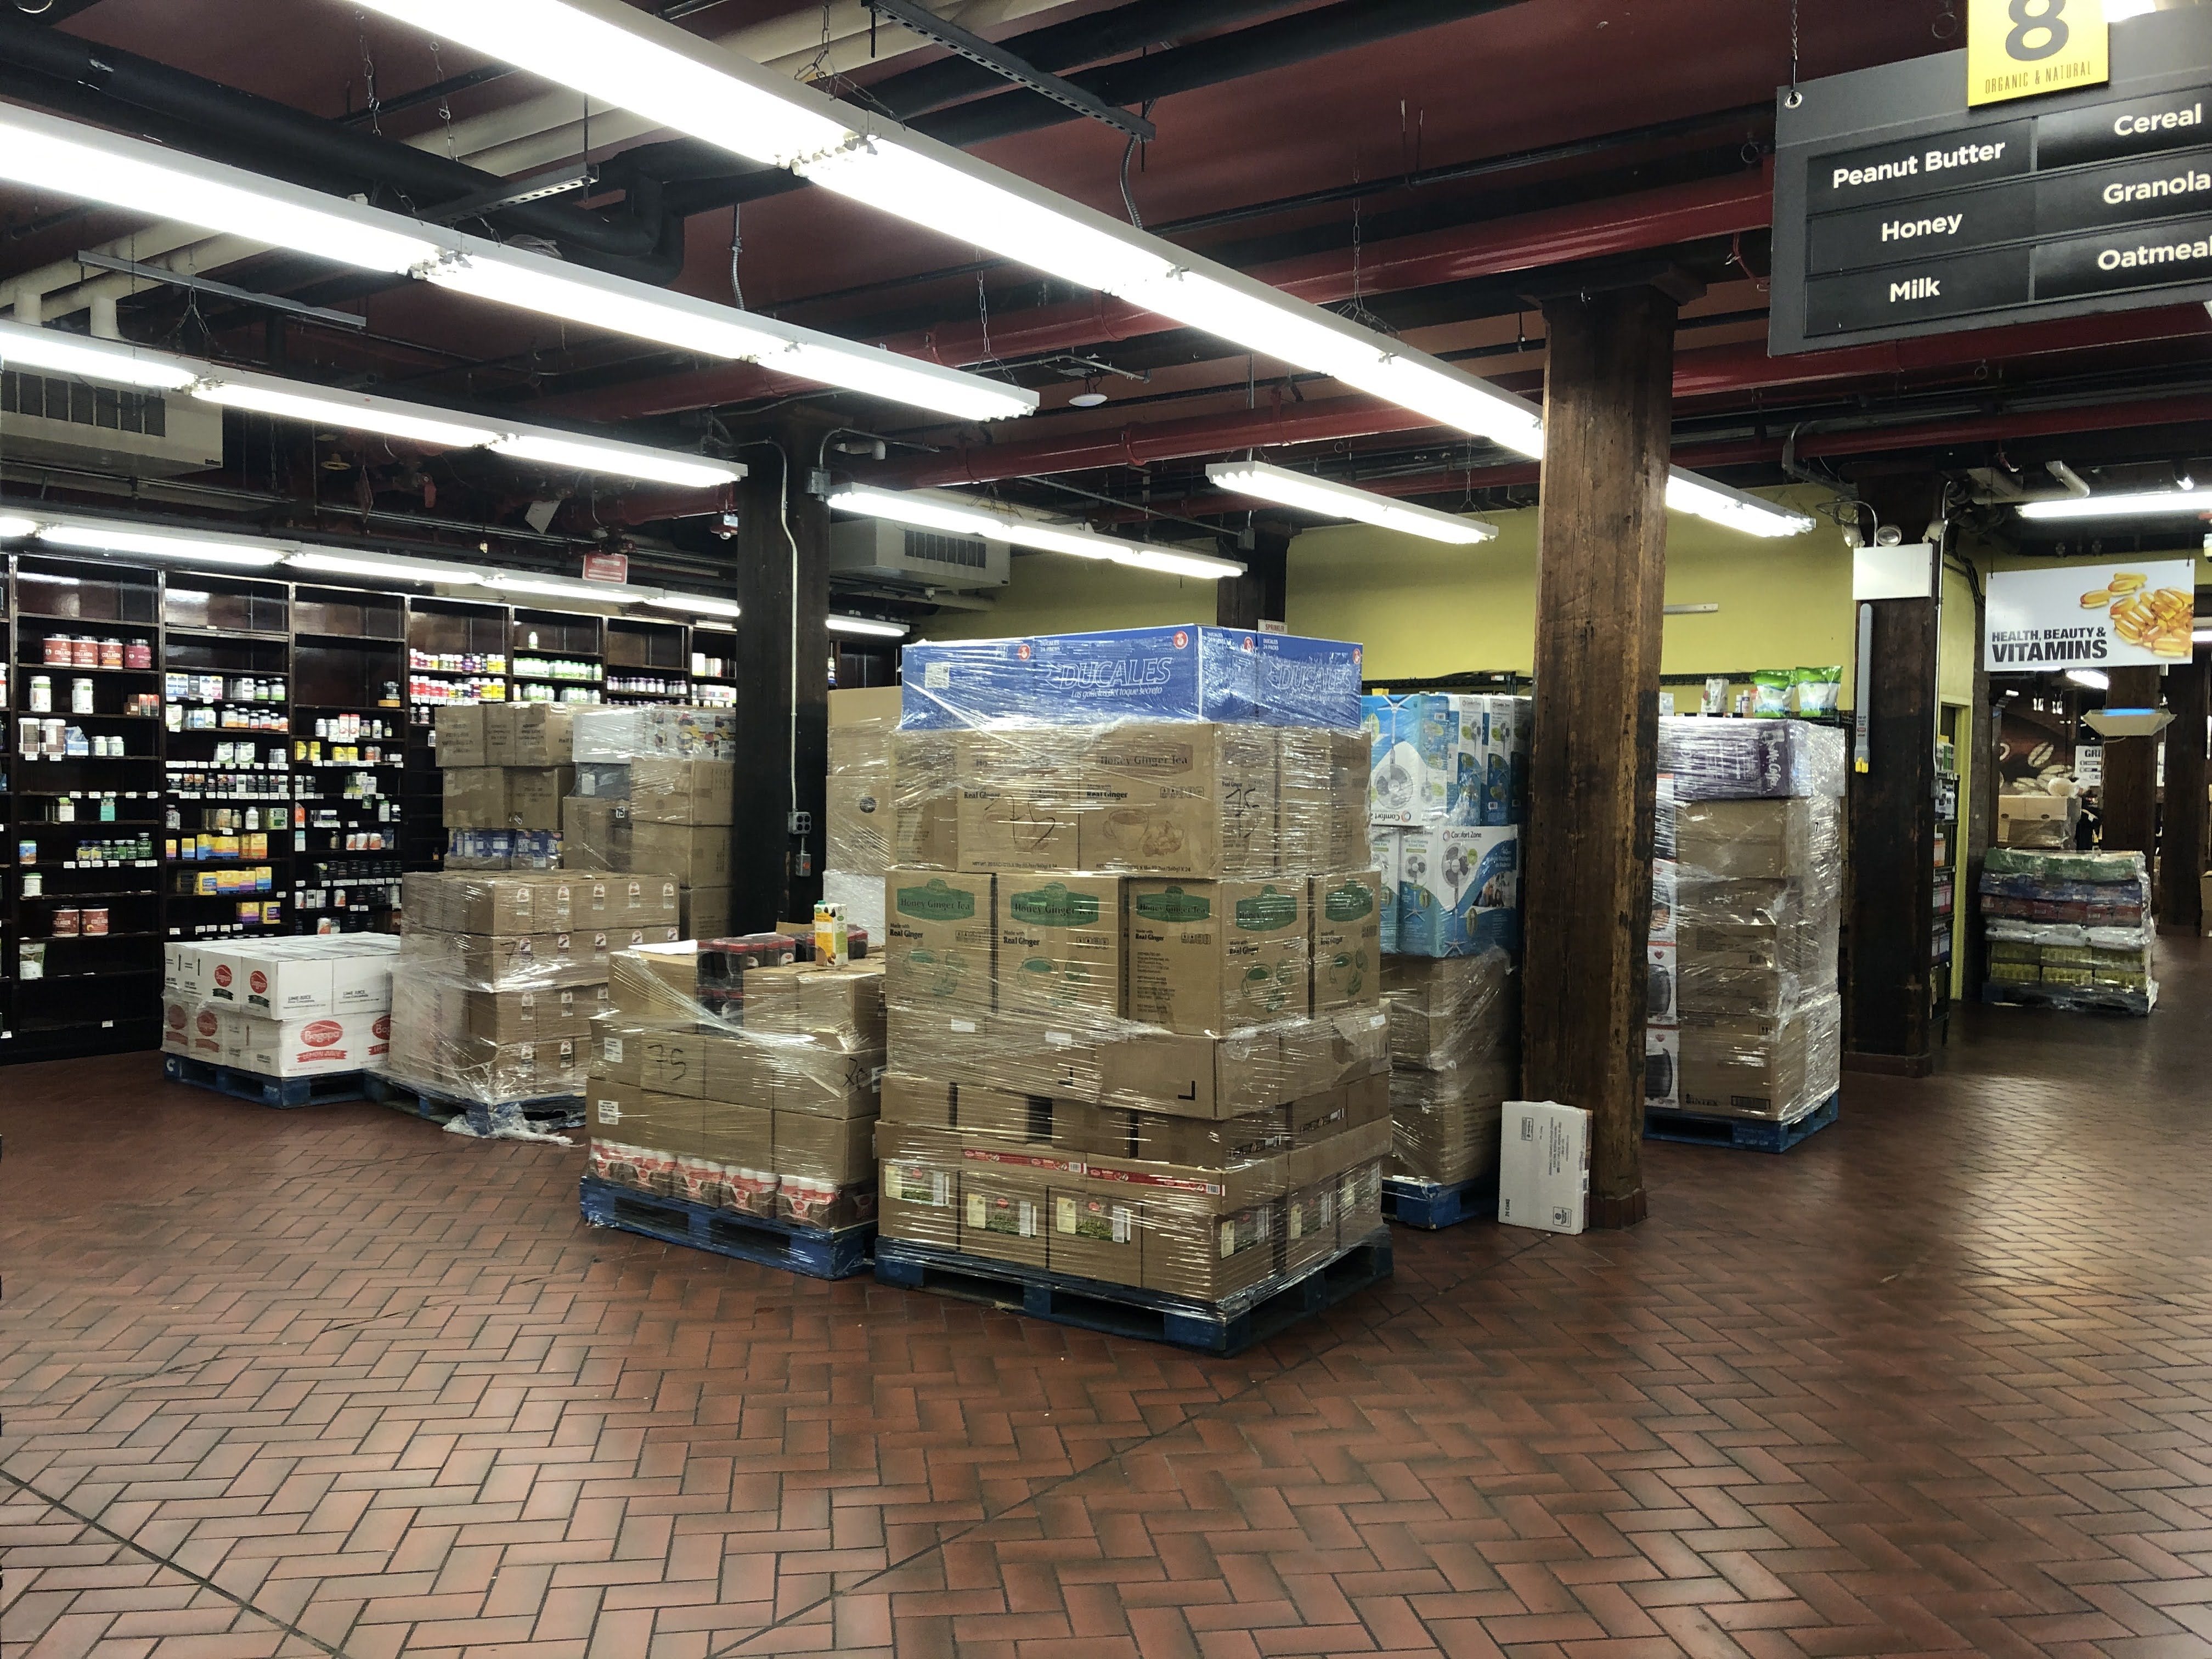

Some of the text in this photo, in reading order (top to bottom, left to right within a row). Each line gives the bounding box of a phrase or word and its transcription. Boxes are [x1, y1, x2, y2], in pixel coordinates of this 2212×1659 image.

[2005, 0, 2069, 61] 8
[1985, 61, 2091, 94] ORGANIC & NATURAL
[2114, 104, 2202, 137] Cereal
[1833, 140, 2006, 189] Peanut Butter
[2103, 170, 2211, 205] Granola
[1882, 213, 1963, 242] Honey
[1890, 277, 1941, 303] Milk
[1992, 627, 2106, 642] HEALTH, BEAUTY &
[1992, 640, 2108, 662] VITAMINS
[1059, 657, 1173, 690] DUCALES
[1278, 664, 1352, 695] DUCALES
[1119, 687, 1138, 697] toque
[1134, 755, 1168, 767] Ginger
[964, 791, 979, 799] Real
[1375, 812, 1400, 821] Comfort
[901, 898, 970, 911] Honey Ginger Tea
[1015, 903, 1042, 915] Honey
[1045, 905, 1074, 916] Ginger
[1140, 904, 1163, 912] Honey
[1165, 905, 1190, 915] Ginger
[904, 930, 923, 939] Ginger
[1003, 936, 1040, 947] Real Ginger
[1229, 946, 1242, 955] Real
[304, 1030, 340, 1043] Bogopa
